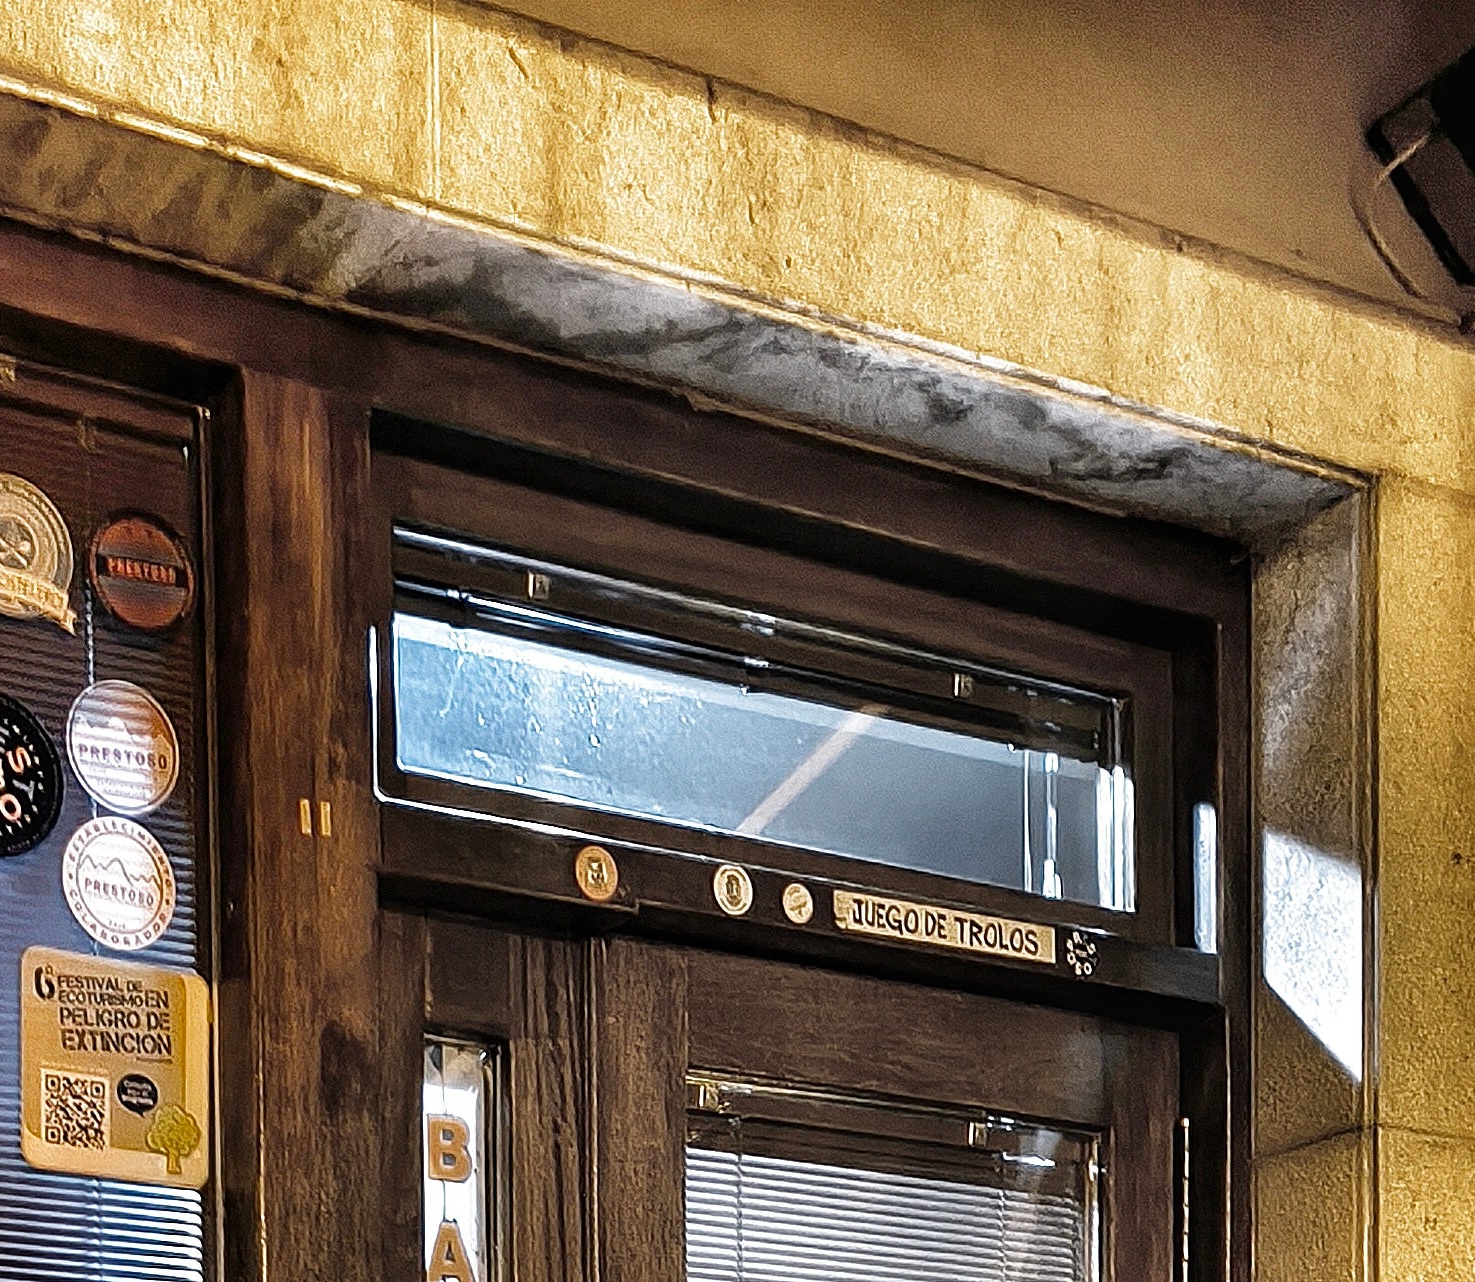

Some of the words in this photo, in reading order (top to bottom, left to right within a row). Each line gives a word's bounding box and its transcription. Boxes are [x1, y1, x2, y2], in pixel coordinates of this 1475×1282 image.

[78, 743, 167, 769] PRESTOSO
[84, 877, 154, 907] PRESTOSO
[68, 889, 168, 947] COLABORADOR
[852, 898, 918, 935] JUEGO
[924, 914, 947, 939] DE
[954, 916, 1040, 956] TROLOS
[58, 975, 123, 992] FESTIVAL
[127, 980, 144, 993] DE
[58, 990, 144, 1008] ECOTURISMO
[145, 991, 169, 1009] EN
[59, 1008, 141, 1029] PELIGRO
[146, 1012, 171, 1032] DE
